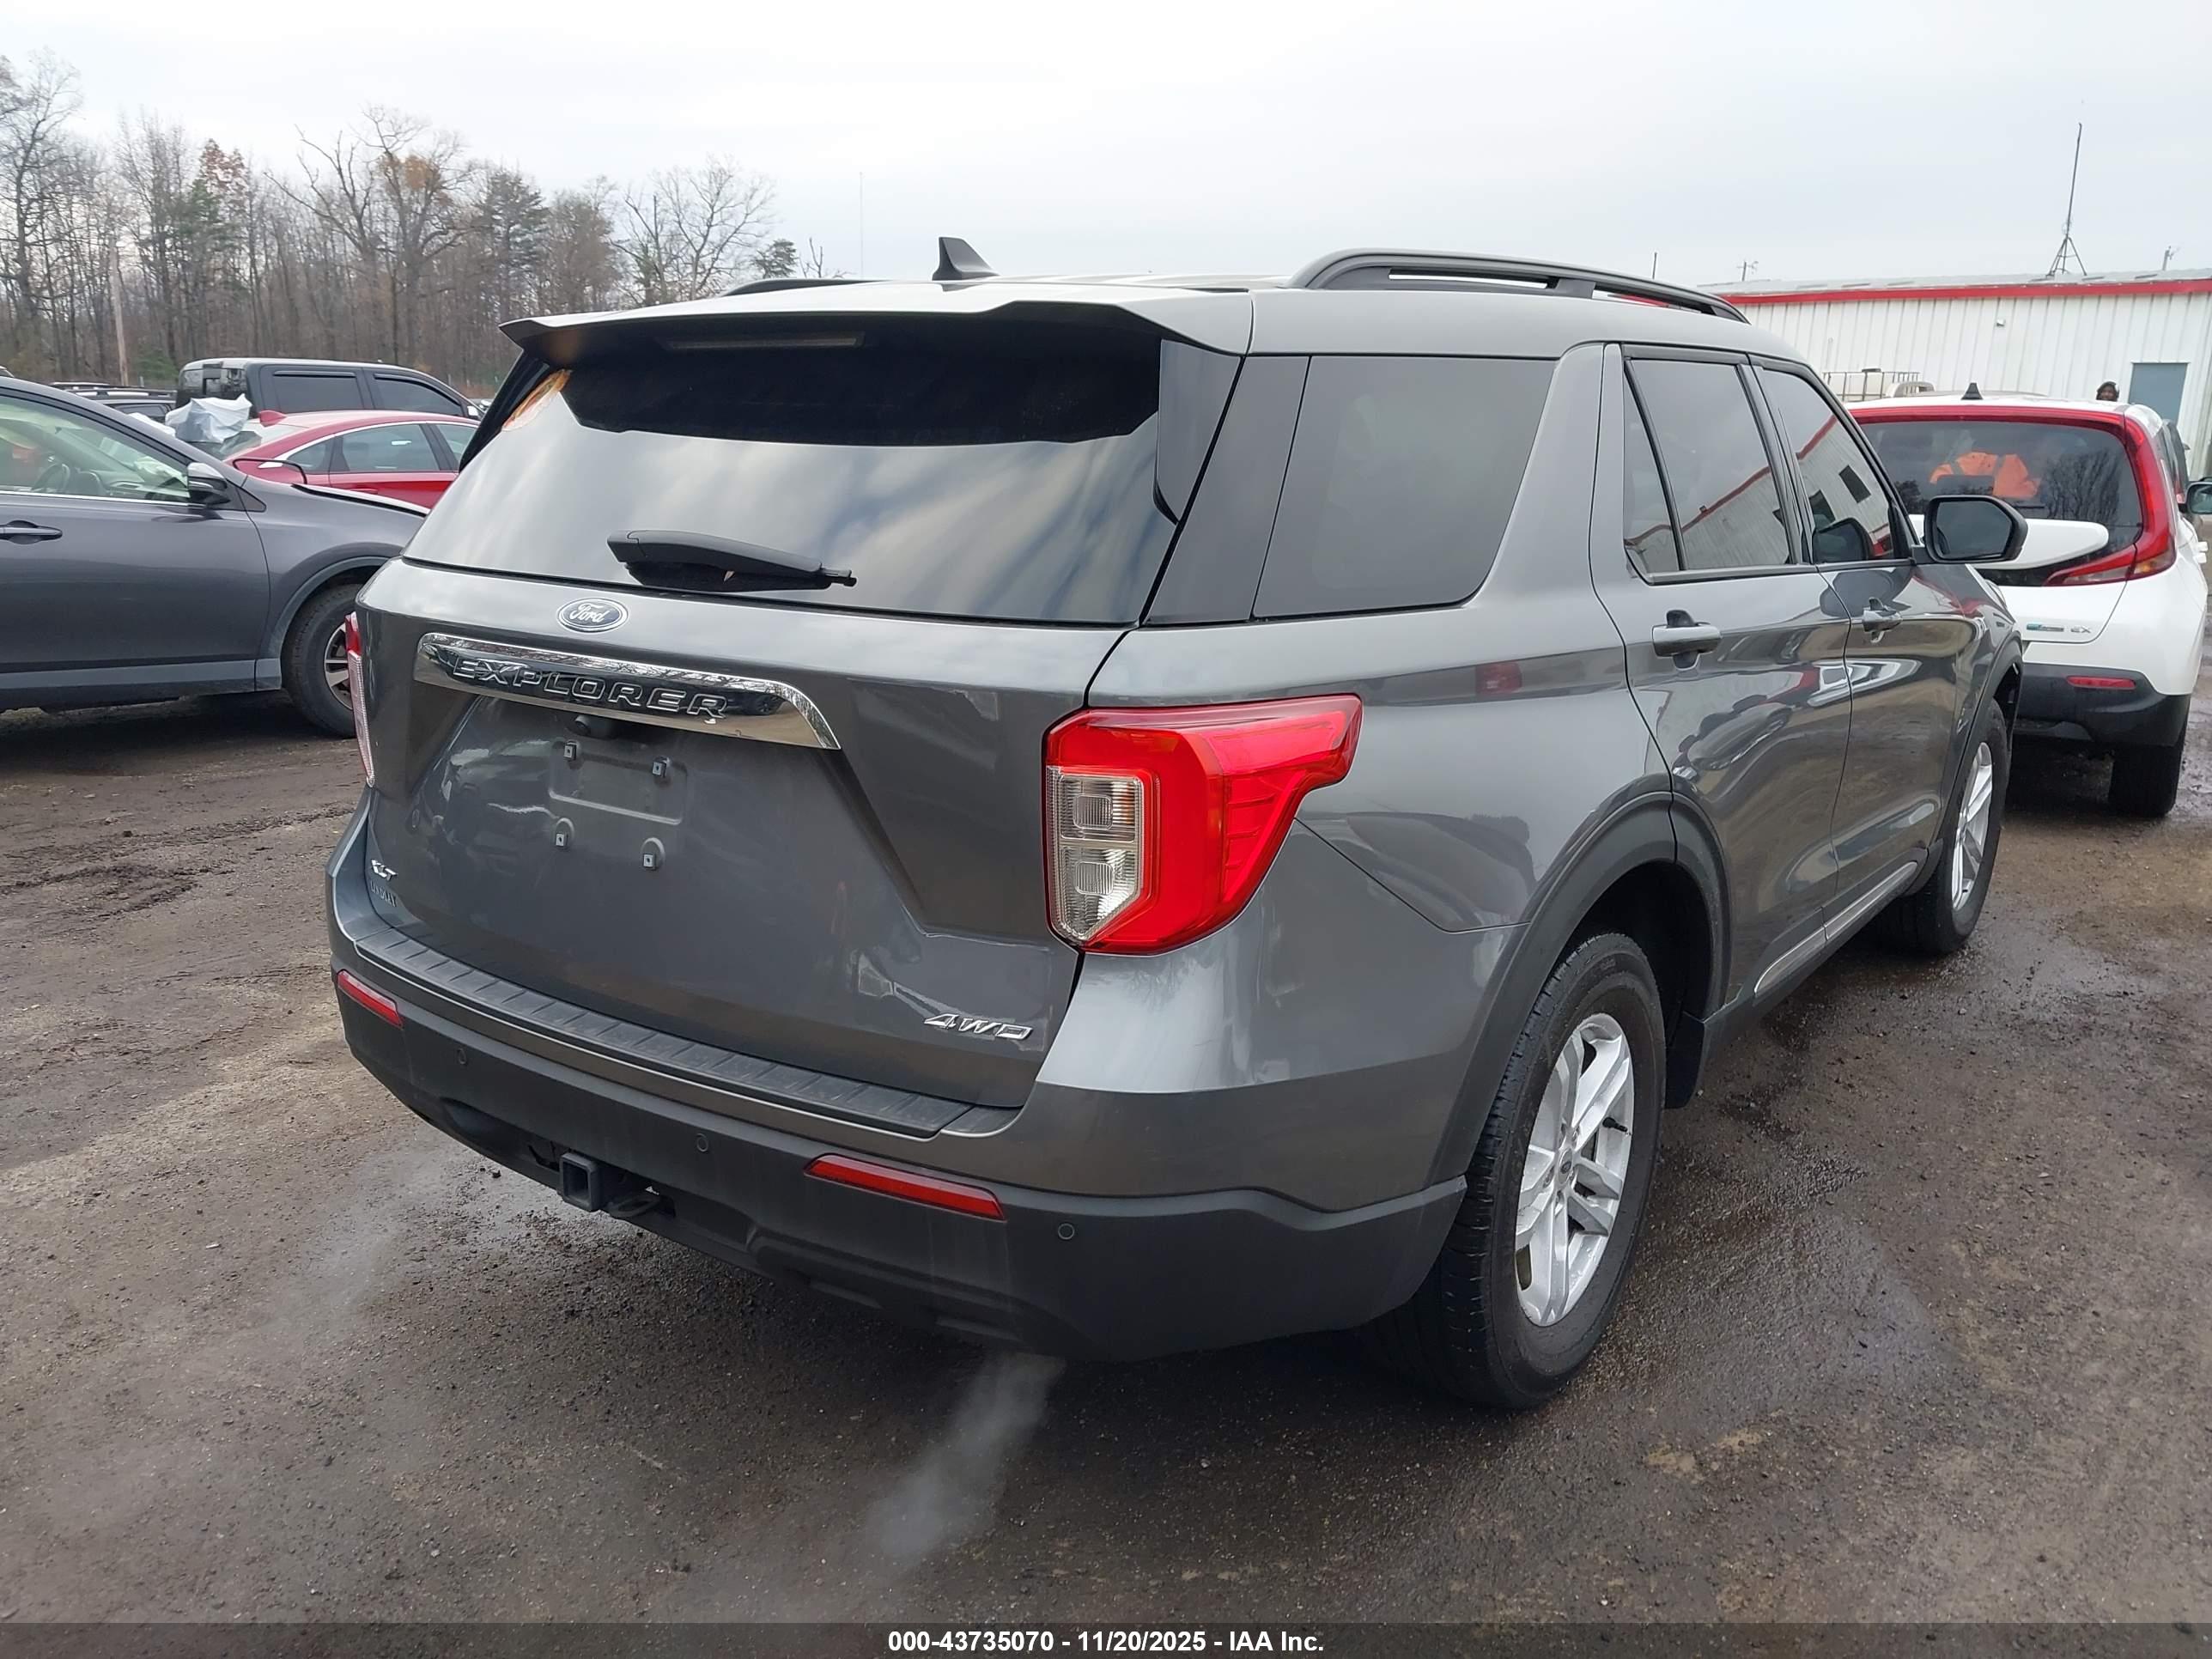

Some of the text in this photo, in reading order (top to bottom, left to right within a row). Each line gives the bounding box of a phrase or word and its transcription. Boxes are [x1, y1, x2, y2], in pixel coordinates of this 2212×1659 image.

[569, 603, 611, 623] Ford
[453, 656, 728, 720] EXPLORER
[924, 1013, 1034, 1040] 4WD
